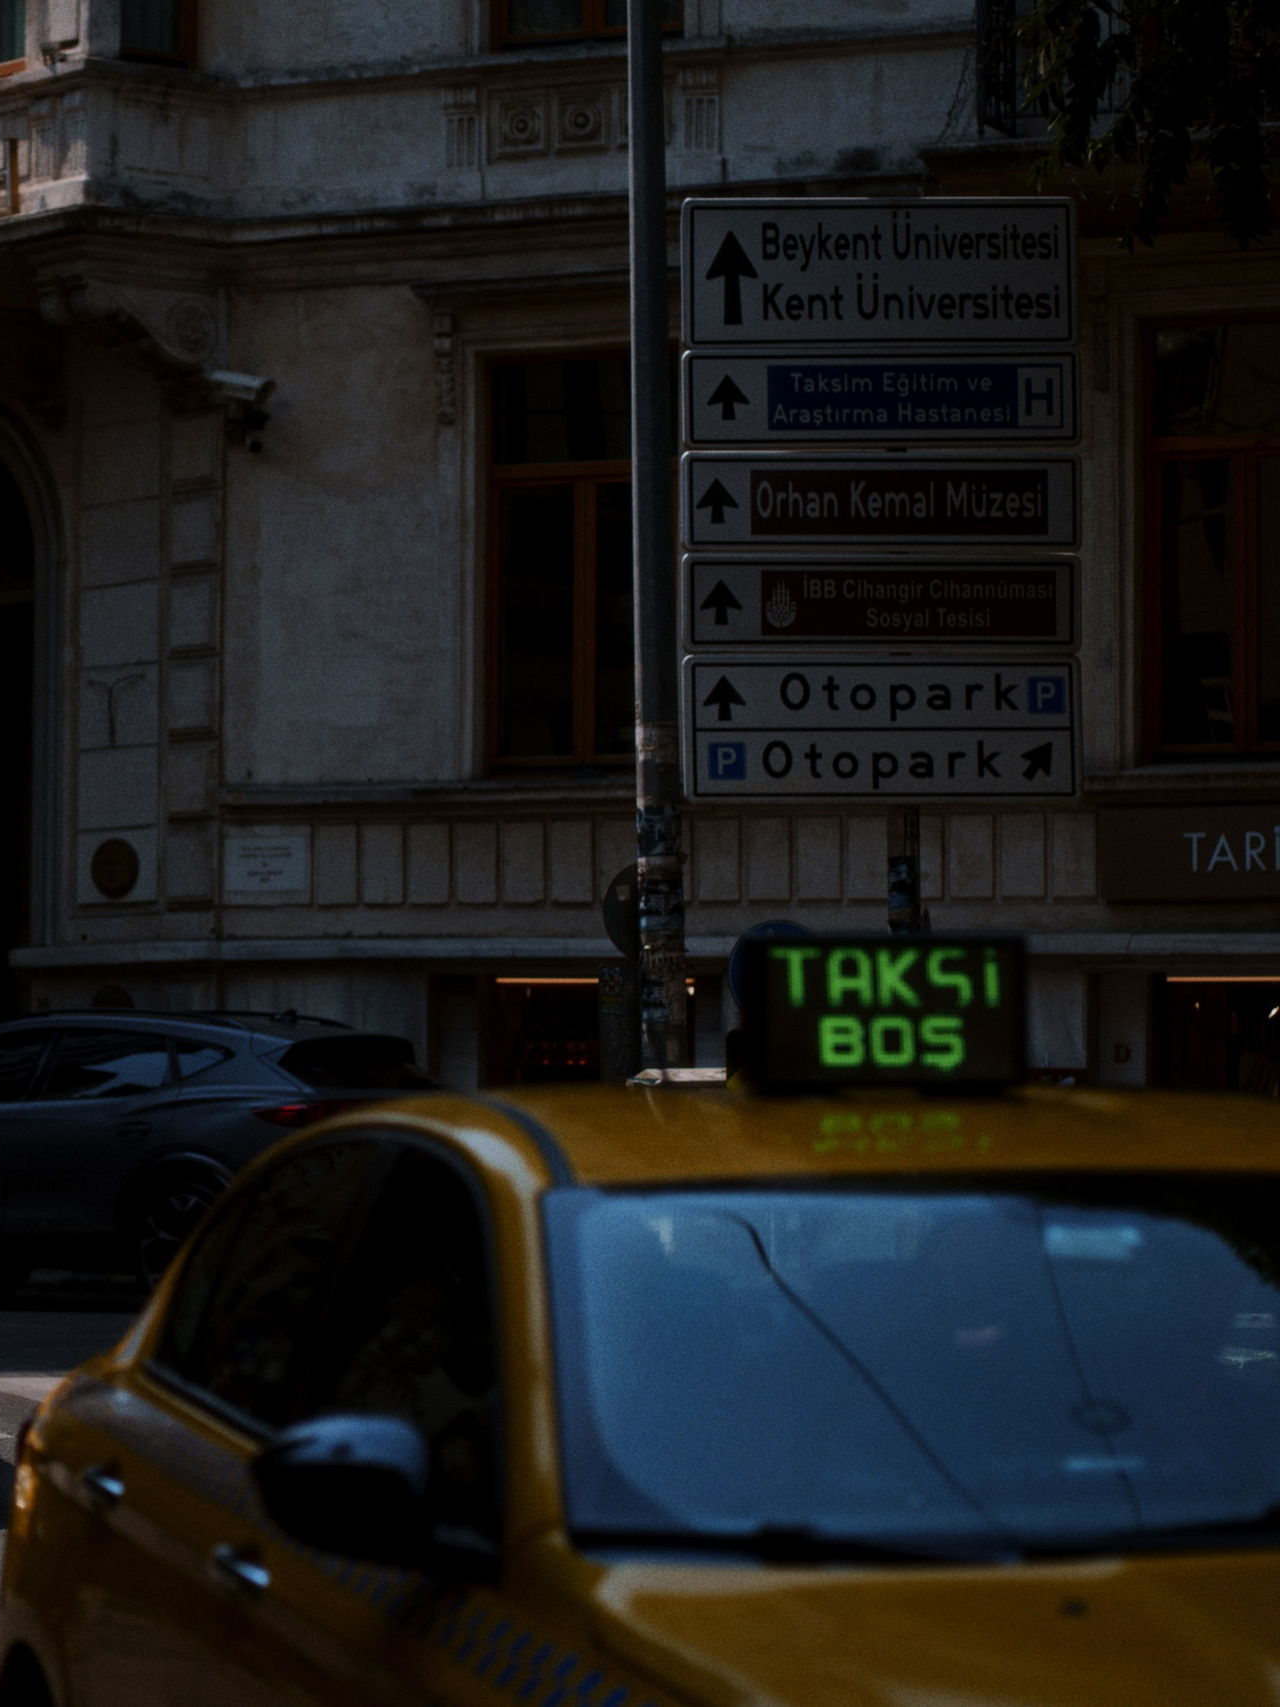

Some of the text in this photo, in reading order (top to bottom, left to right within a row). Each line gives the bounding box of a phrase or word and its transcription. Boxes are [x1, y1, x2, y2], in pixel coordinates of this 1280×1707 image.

[762, 212, 1059, 271] Beykent Üniversitesi
[763, 273, 1060, 320] Kent Üniversitesi
[790, 371, 993, 398] Taksim Eğitim ve
[773, 403, 1011, 426] Araştırma Hastanesi
[756, 480, 1043, 519] Orhan Kemal Müzesi
[802, 574, 1053, 604] İBB Cihangir Cihannüması
[866, 607, 991, 632] Sosyal Tesisi
[780, 673, 1057, 721] Otopark P
[717, 740, 1001, 789] P Otopark
[818, 1014, 968, 1073] BOŞ
